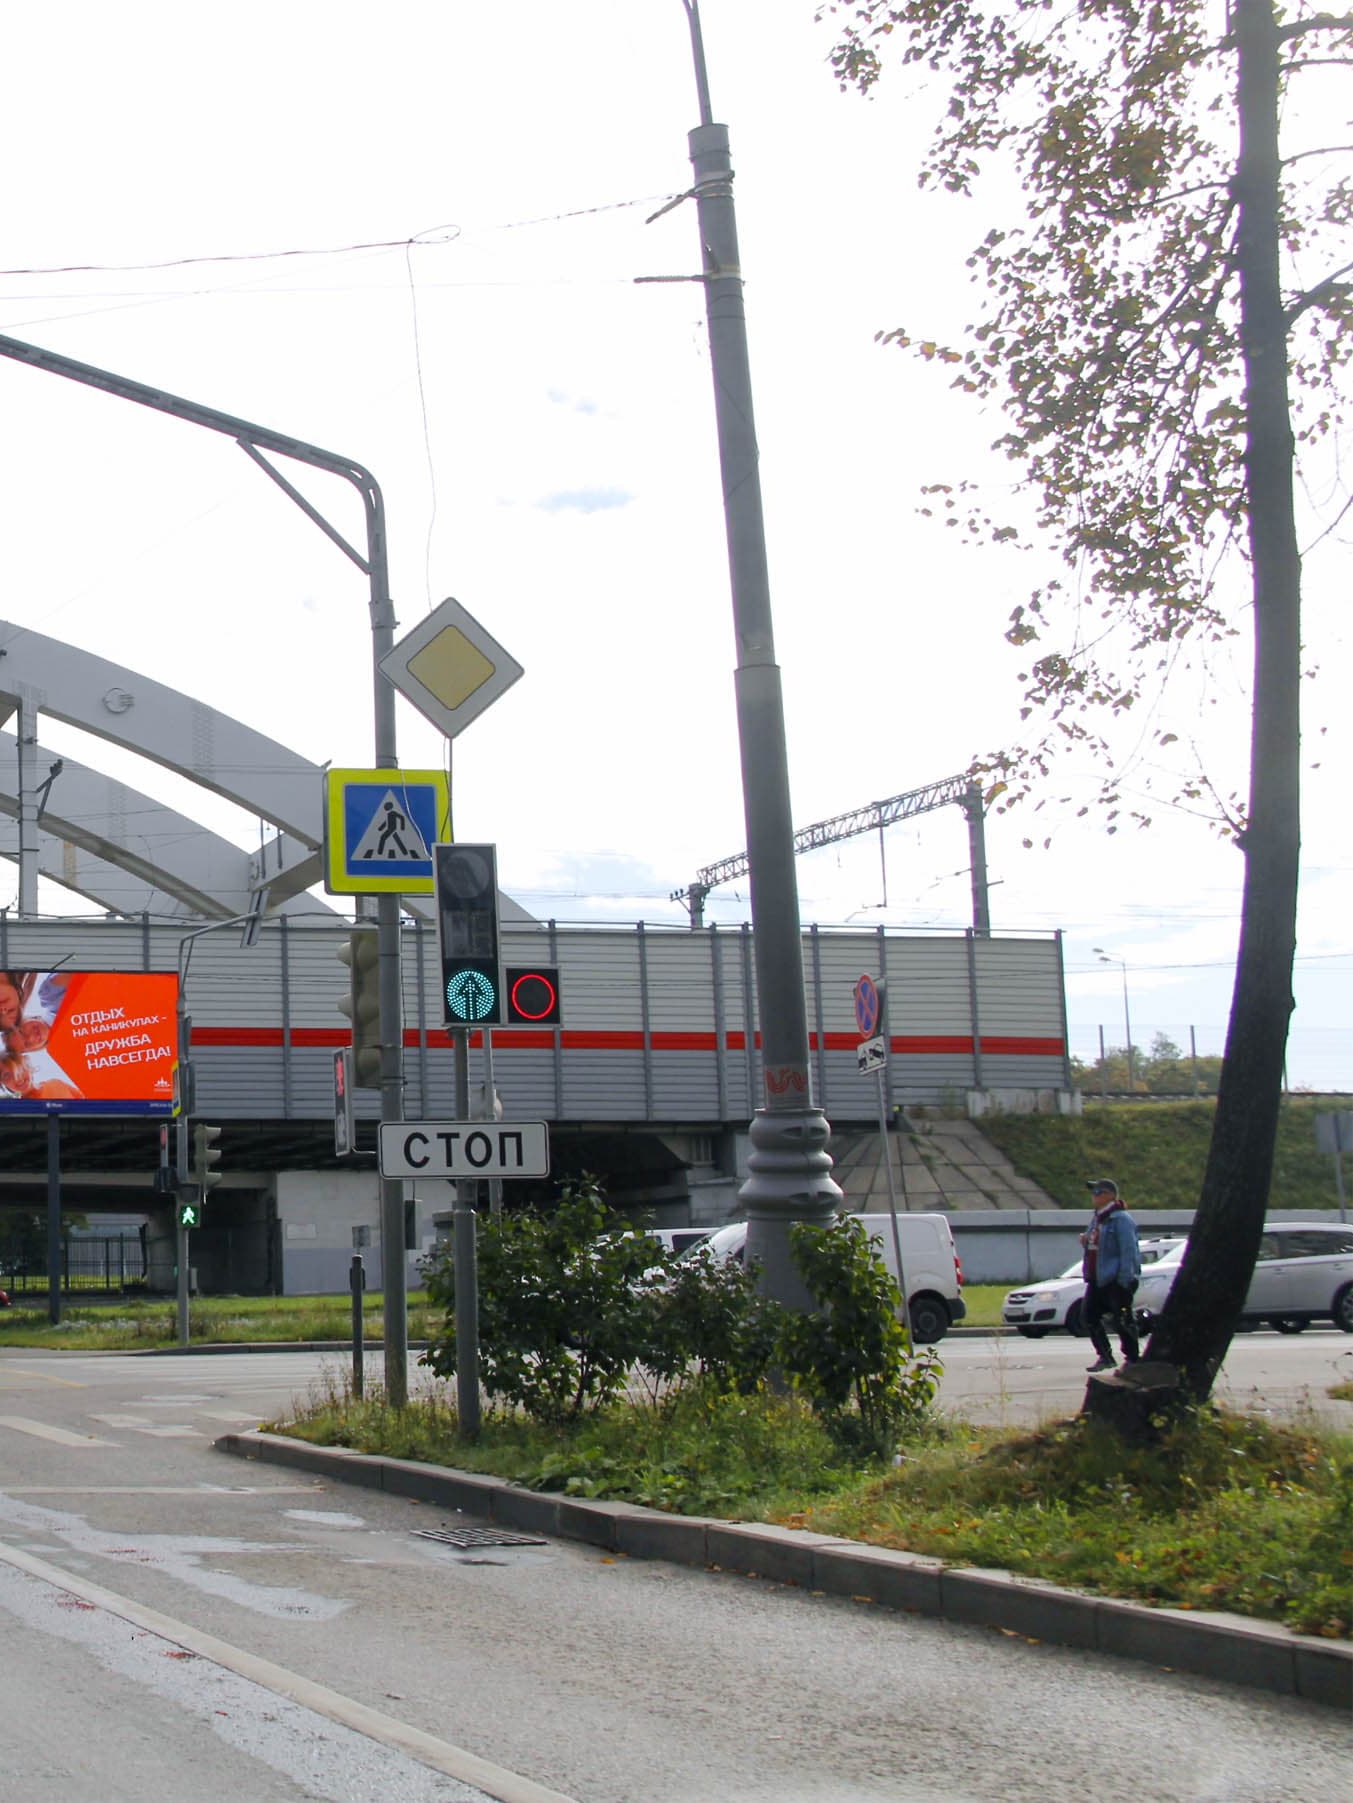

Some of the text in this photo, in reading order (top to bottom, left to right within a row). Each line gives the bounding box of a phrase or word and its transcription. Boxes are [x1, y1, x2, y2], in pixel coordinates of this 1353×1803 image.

[70, 1007, 125, 1026] ОТДЫХ
[72, 1027, 89, 1038] НА
[91, 1015, 160, 1034] КАНИКУЛАХ
[85, 1033, 152, 1056] ДРУЖБА
[87, 1045, 171, 1070] НАВСЕГДА!
[403, 1130, 524, 1169] СТОП
